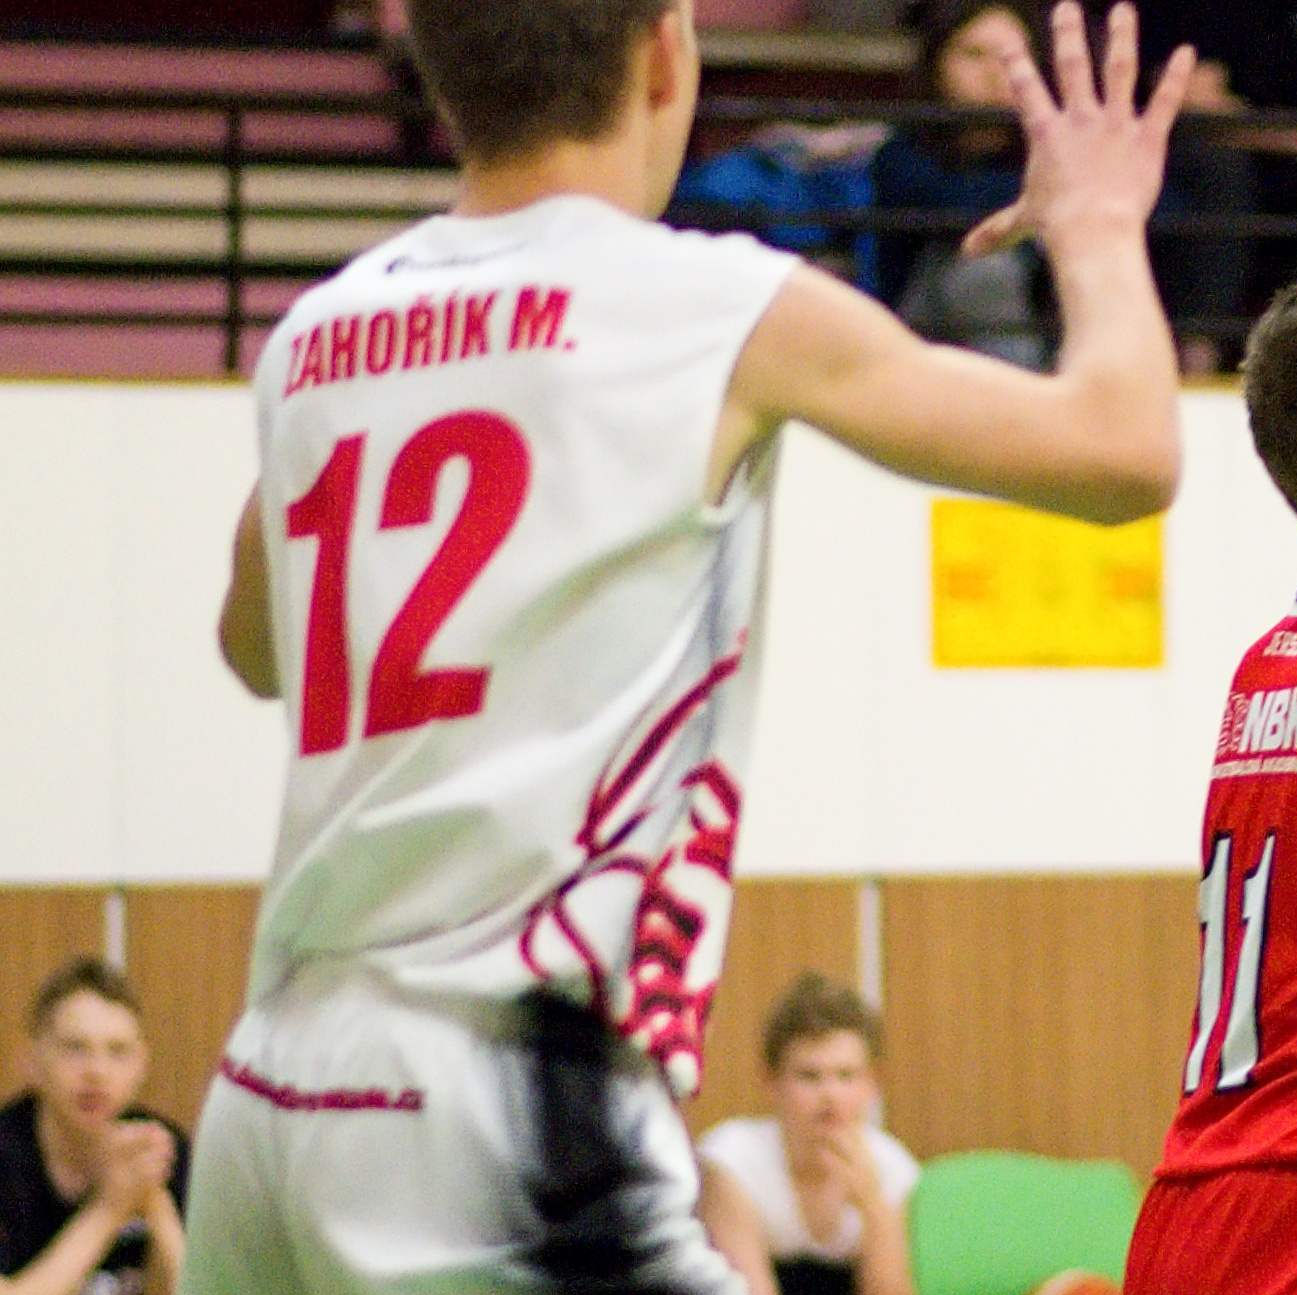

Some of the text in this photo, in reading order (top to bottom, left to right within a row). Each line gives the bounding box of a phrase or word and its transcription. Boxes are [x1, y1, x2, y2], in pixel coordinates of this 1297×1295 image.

[508, 284, 577, 351] M.
[284, 409, 533, 760] 12
[1184, 832, 1276, 1092] 11
